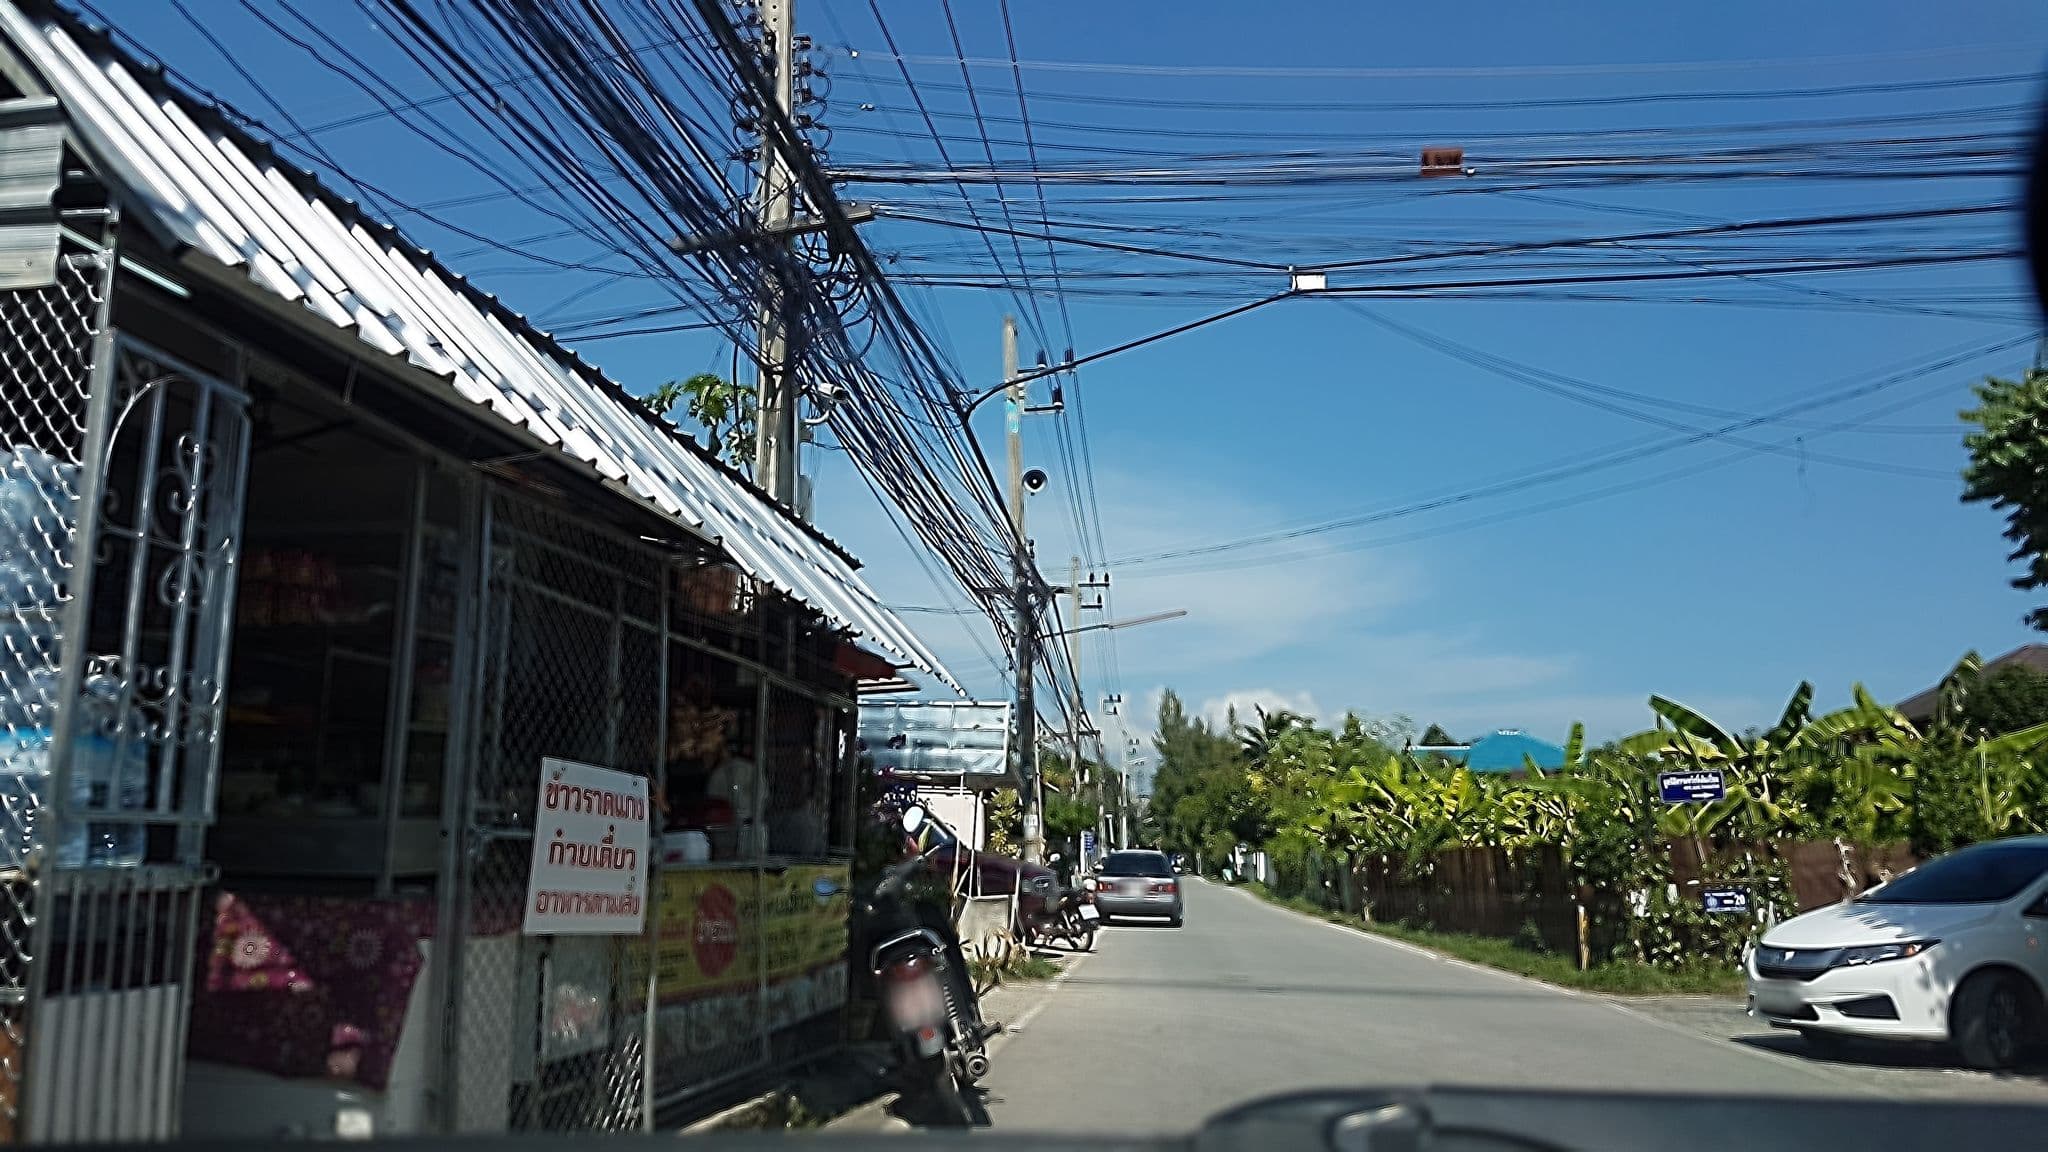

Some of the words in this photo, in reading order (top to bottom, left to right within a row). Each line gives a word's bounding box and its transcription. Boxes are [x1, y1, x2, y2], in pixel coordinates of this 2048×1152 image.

[545, 768, 646, 821] ข้าวราดแกง
[548, 824, 637, 871] ก๋วยเตี๋ยว
[535, 876, 641, 916] อาหารตามสั่ง
